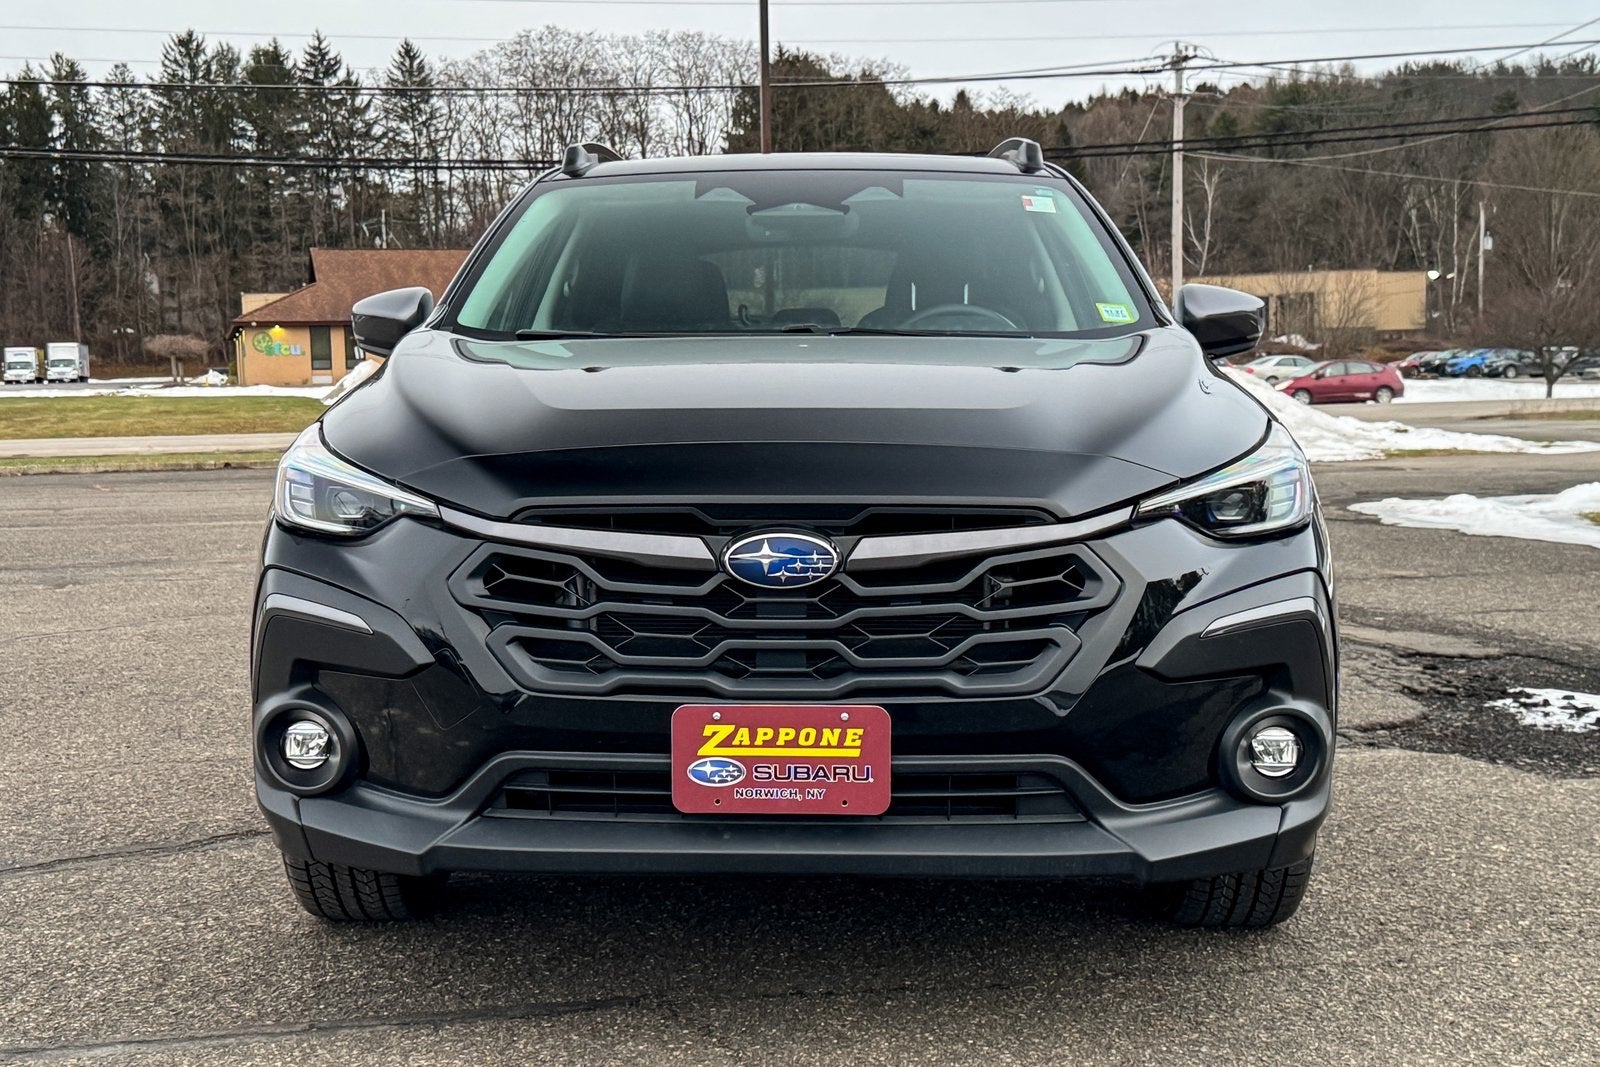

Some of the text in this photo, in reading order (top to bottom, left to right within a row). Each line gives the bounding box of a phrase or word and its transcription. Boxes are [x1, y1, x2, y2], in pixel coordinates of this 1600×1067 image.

[697, 724, 864, 757] ZAPPONE
[753, 764, 874, 782] SUBARU
[734, 788, 826, 801] NORWICH, NY
